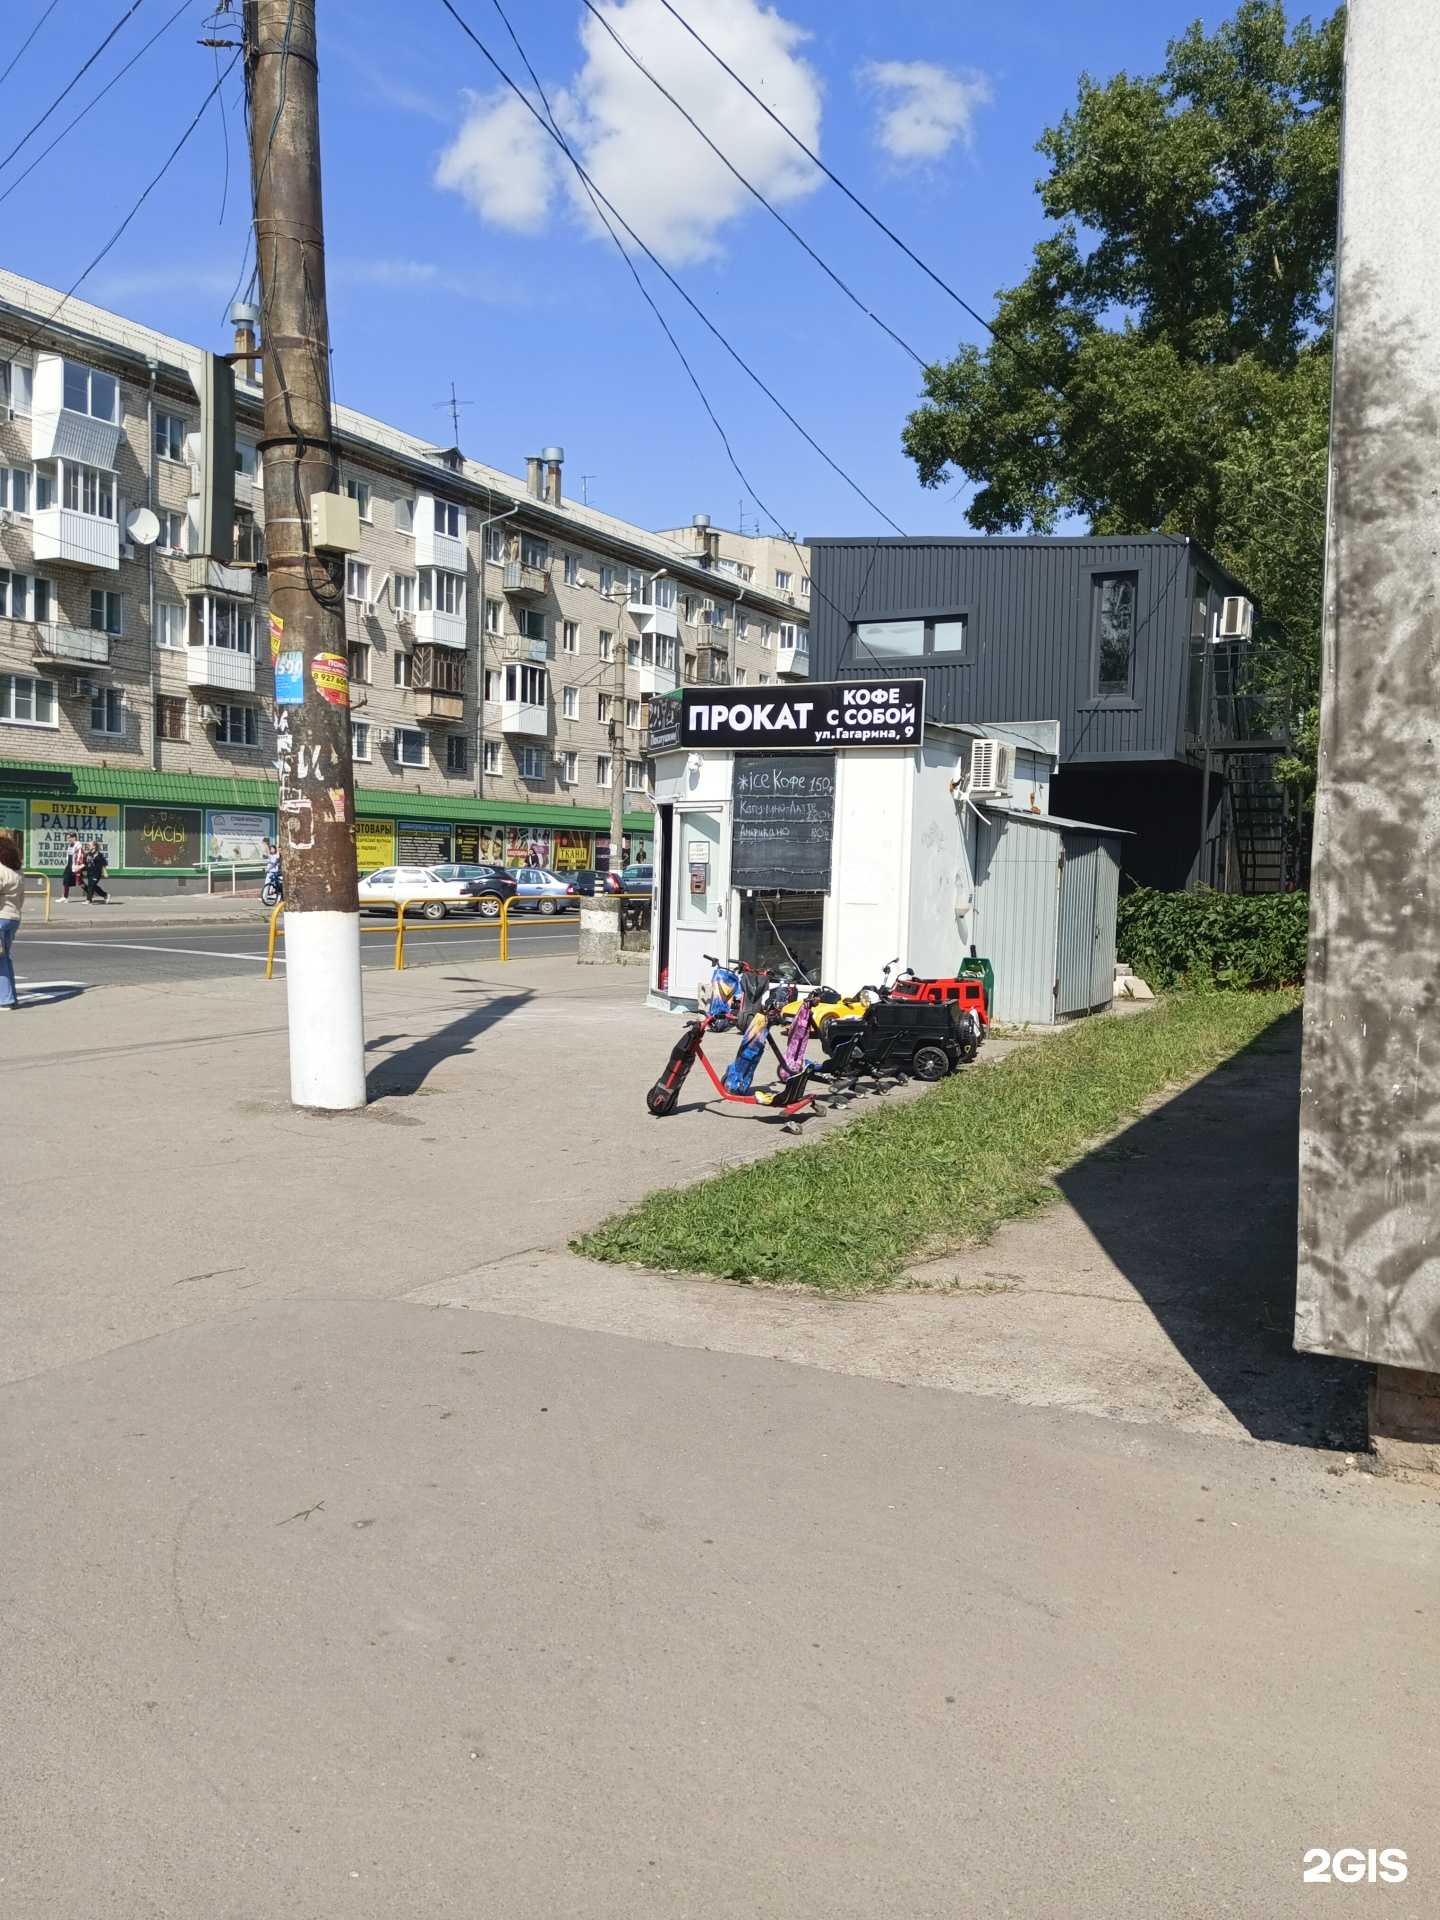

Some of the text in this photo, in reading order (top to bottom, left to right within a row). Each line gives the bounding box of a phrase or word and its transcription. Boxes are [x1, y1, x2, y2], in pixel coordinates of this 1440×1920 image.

[321, 674, 335, 683] 927
[843, 688, 900, 705] КОФЕ
[688, 702, 814, 732] ПРОКАТ
[844, 703, 915, 726] СОБОЙ
[904, 725, 914, 738] 9
[52, 804, 97, 814] ПУЛЬТЫ
[40, 813, 107, 831] РАЦИИ
[44, 832, 104, 843] АНТННЫ
[143, 824, 186, 843] ЧАСЫ
[560, 849, 586, 859] ТКАНИ
